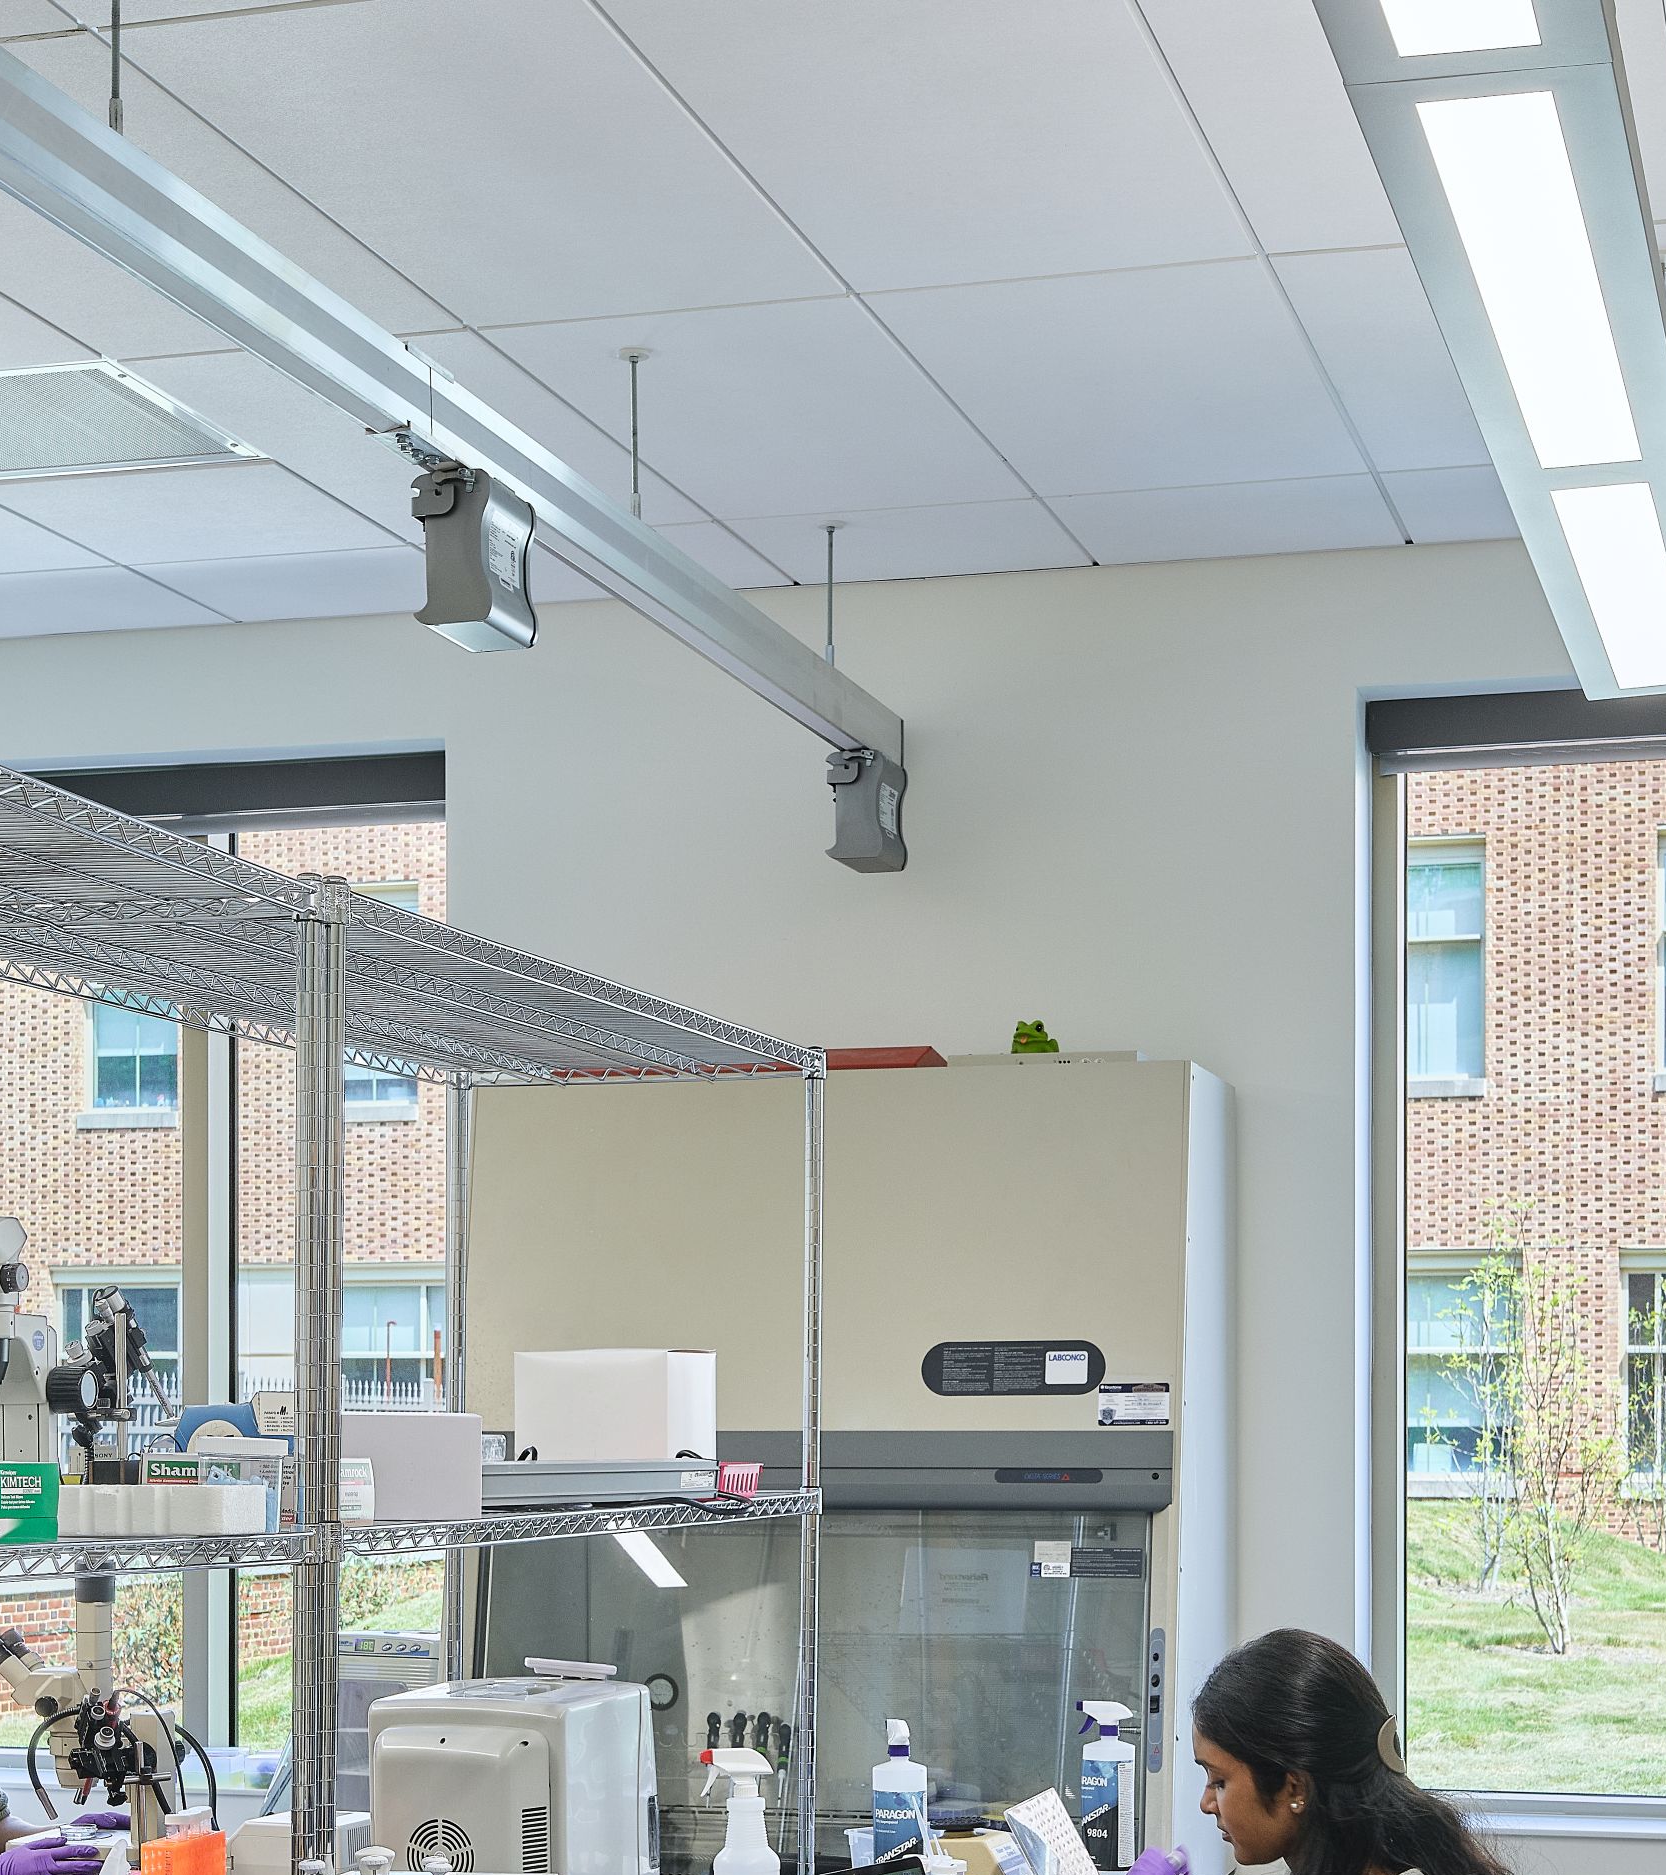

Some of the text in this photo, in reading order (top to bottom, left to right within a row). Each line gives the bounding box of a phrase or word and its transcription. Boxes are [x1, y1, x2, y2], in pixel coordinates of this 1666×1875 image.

[1048, 1353, 1086, 1361] LABCONCO
[340, 1465, 368, 1478] amrock
[0, 1476, 42, 1488] KIMTECH
[1081, 1776, 1108, 1787] RAGON
[876, 1809, 916, 1819] PARAGON
[1087, 1828, 1108, 1839] 9804
